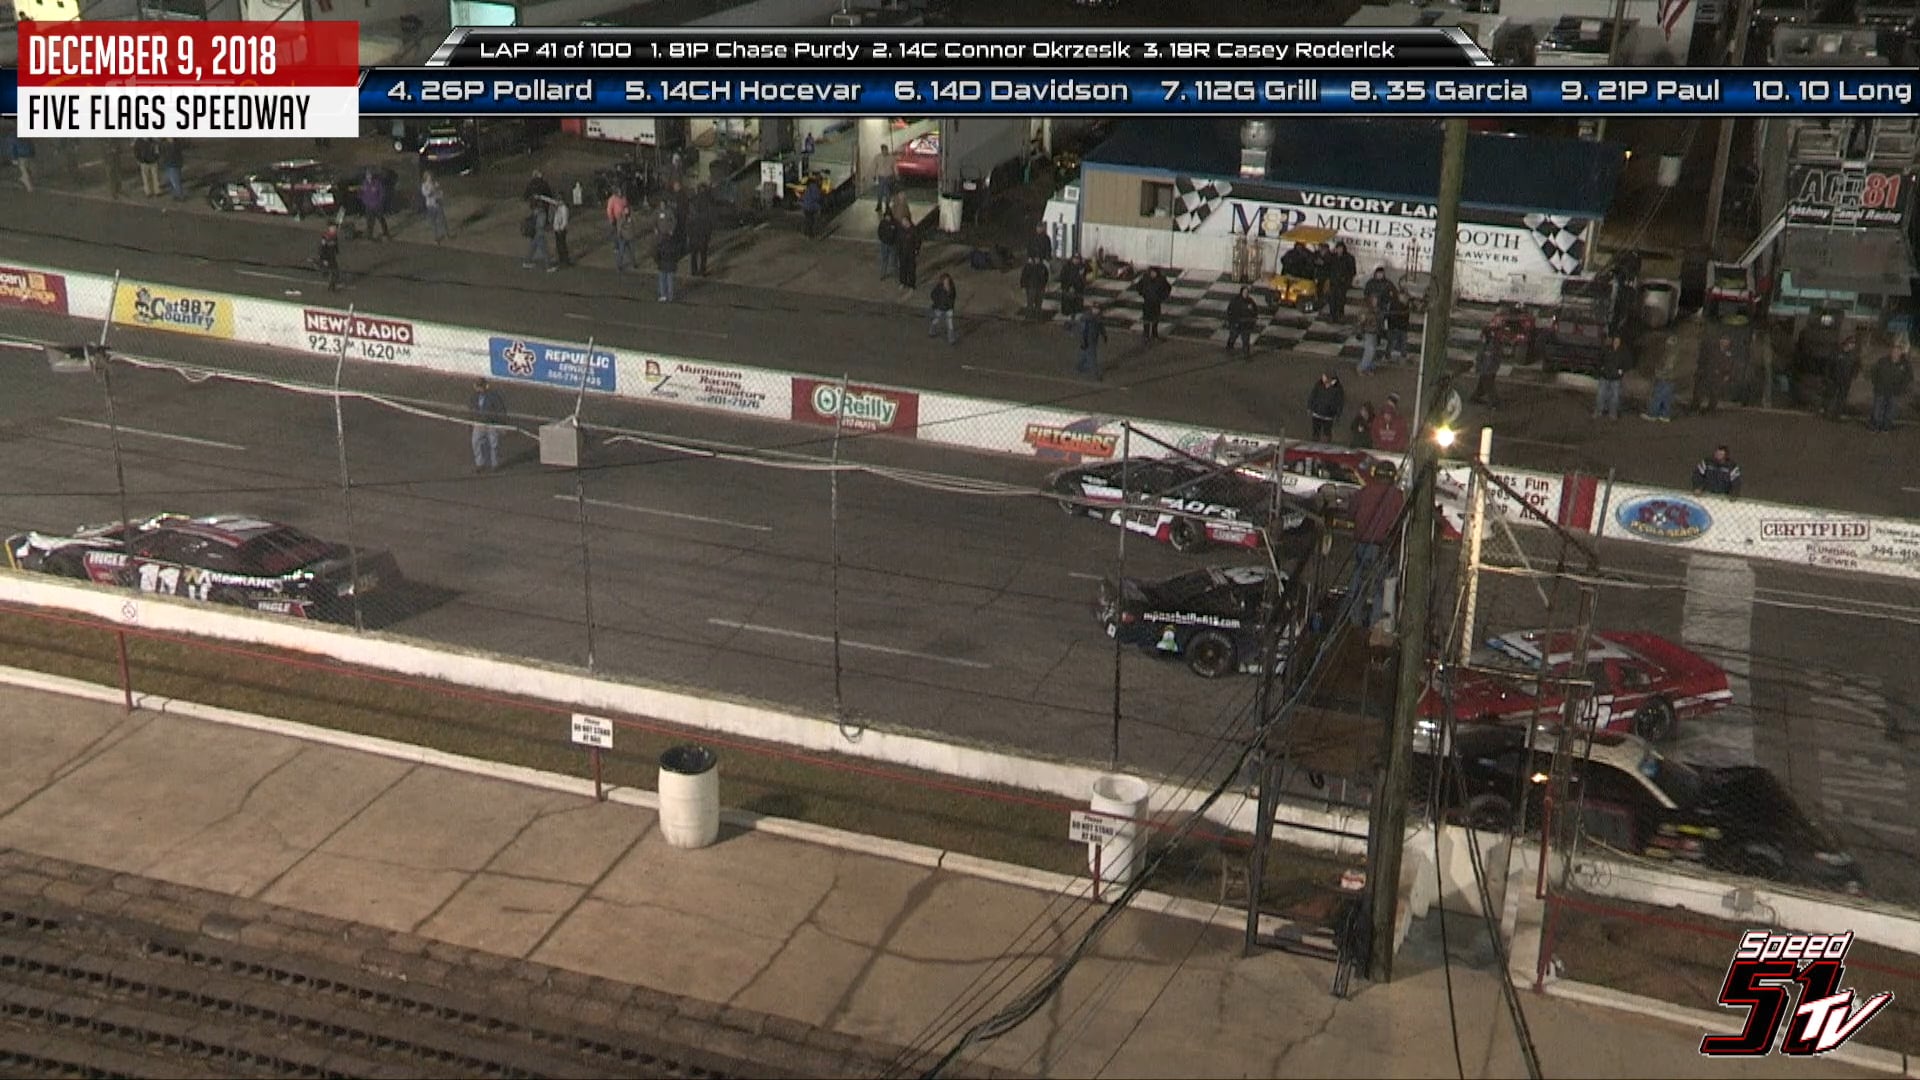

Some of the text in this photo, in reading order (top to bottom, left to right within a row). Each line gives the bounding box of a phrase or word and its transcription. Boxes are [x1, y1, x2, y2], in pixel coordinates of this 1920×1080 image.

[1300, 191, 1394, 214] VICTORY
[1316, 212, 1413, 239] MICHLES
[1456, 229, 1520, 250] OOTH
[356, 320, 411, 343] RADIO
[361, 341, 395, 360] 1620
[1763, 522, 1867, 538] CERTIFIED
